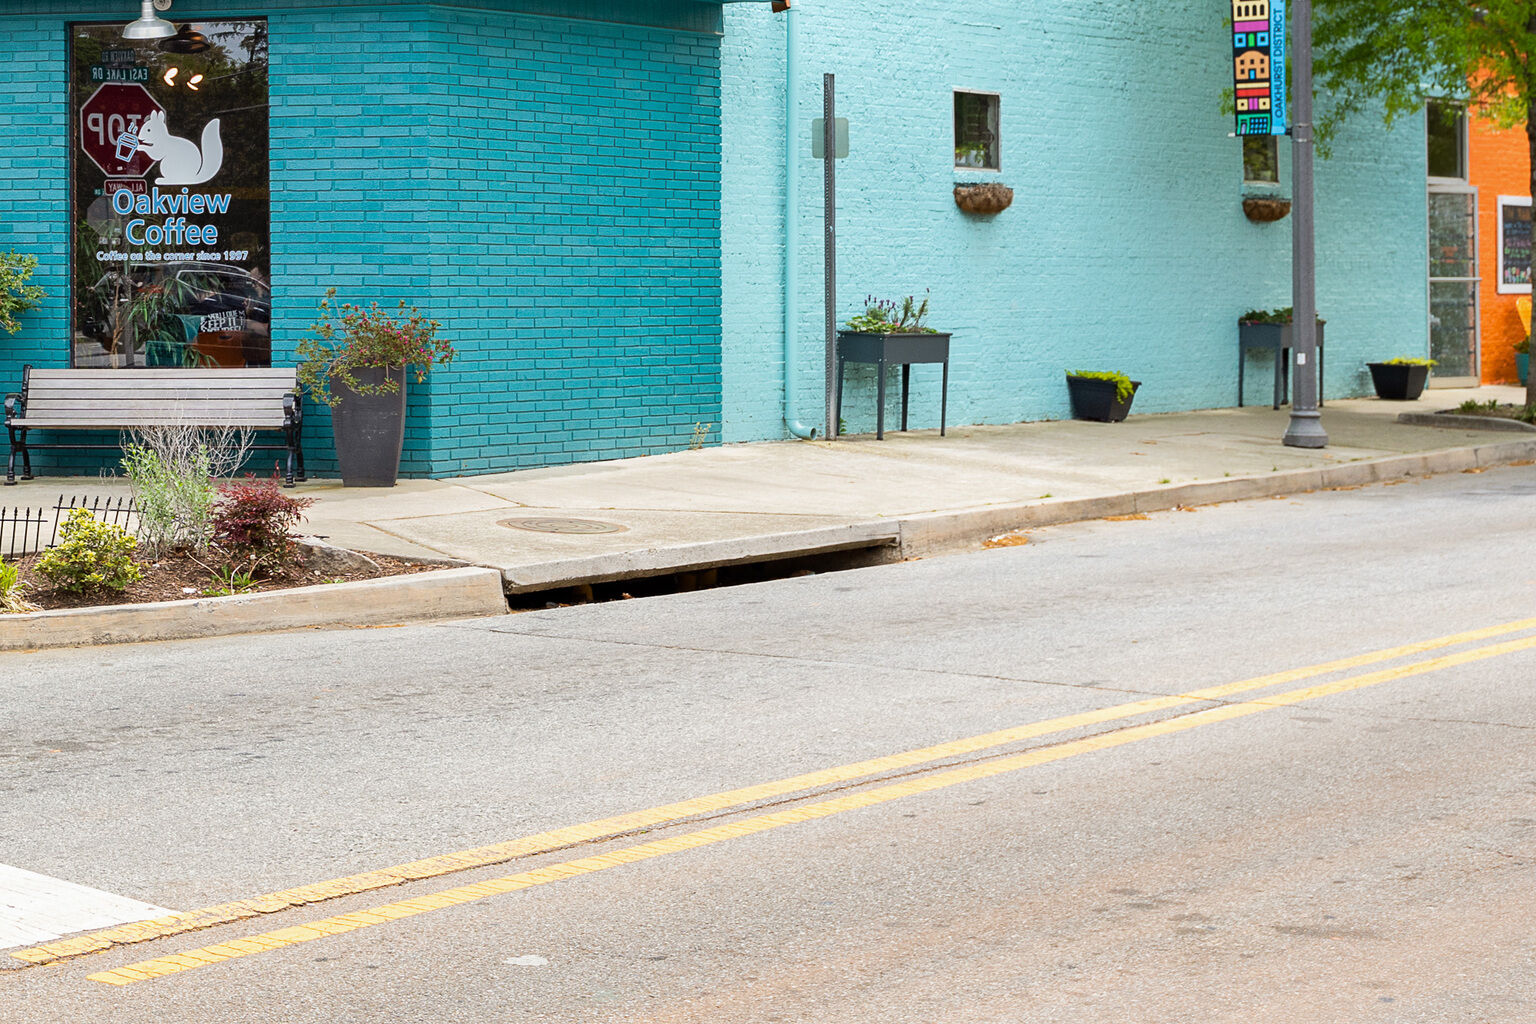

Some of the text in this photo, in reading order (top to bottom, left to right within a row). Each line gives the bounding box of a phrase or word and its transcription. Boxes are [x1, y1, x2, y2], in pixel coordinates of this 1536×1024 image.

[1273, 8, 1283, 118] OAKHURST DISTRICT
[113, 187, 231, 215] Oakview
[126, 217, 218, 245] Coffee
[96, 250, 248, 261] Coffee on the corner since 1997
